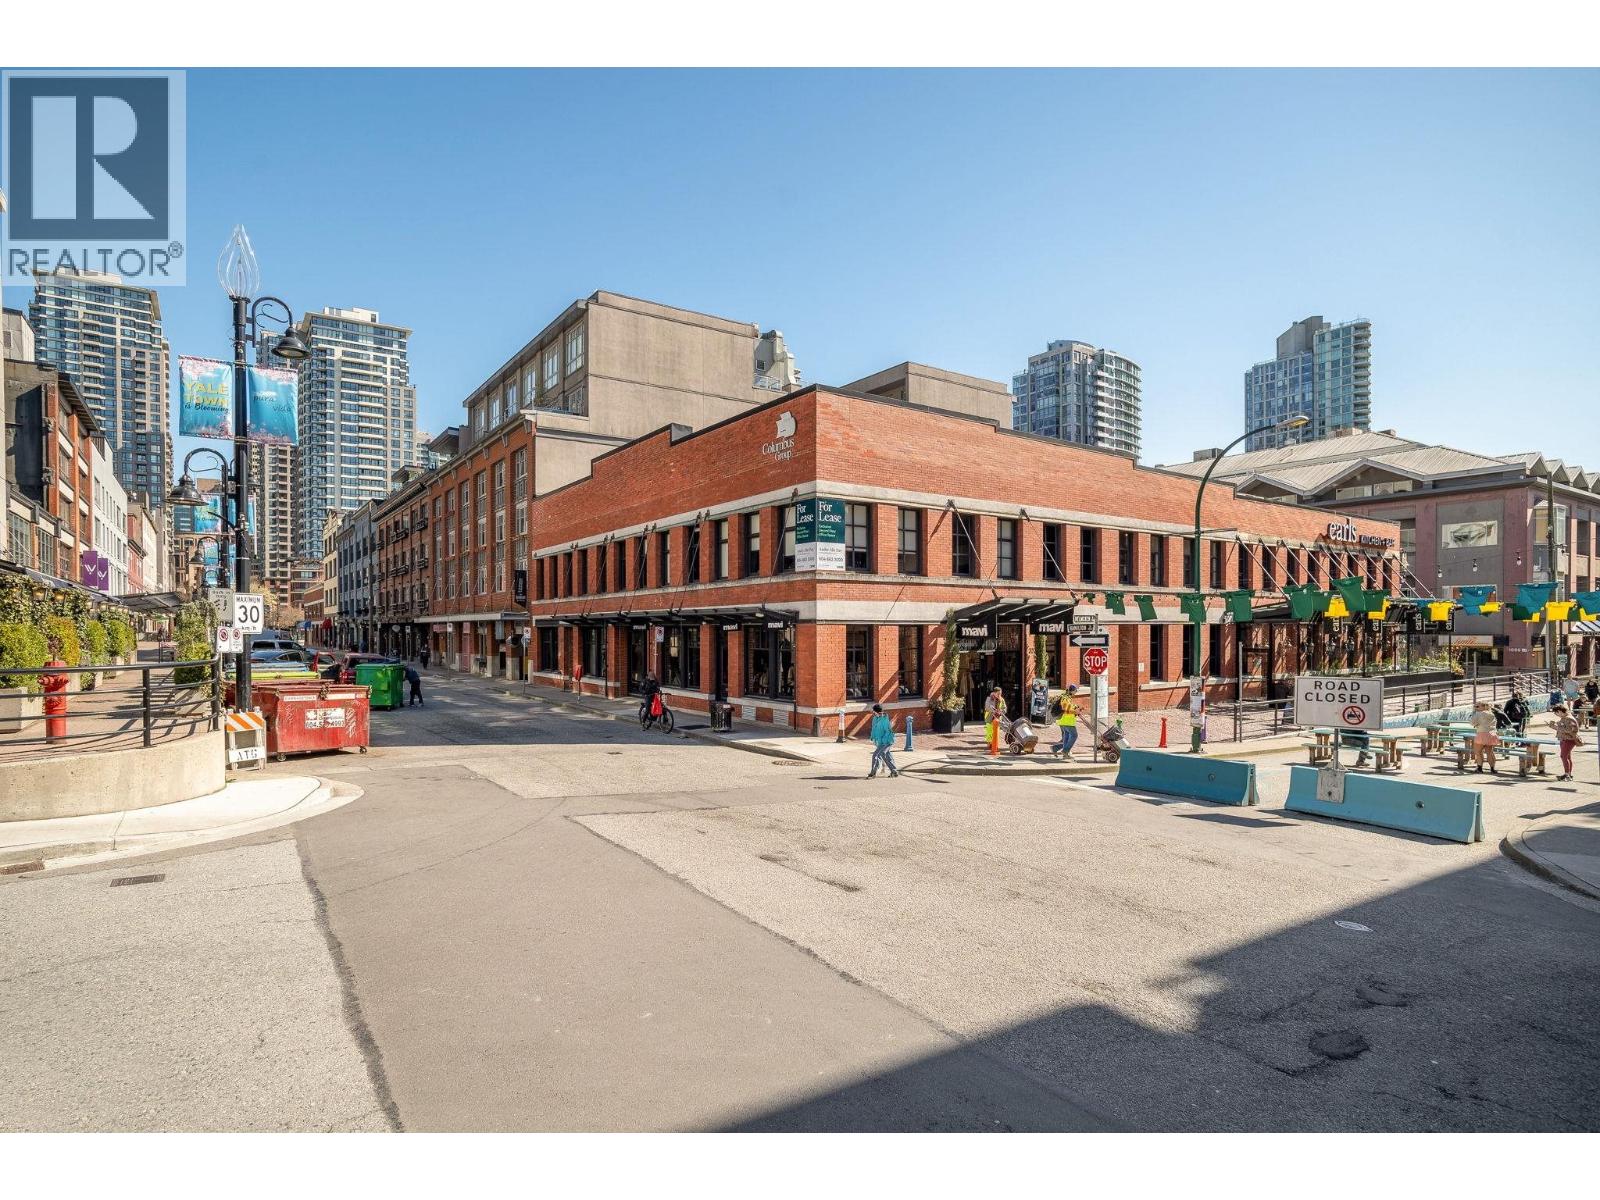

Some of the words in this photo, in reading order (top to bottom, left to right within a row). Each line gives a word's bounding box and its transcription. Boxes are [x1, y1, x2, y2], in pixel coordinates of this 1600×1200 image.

[184, 382, 229, 395] YALE
[762, 438, 795, 455] Columbus
[774, 449, 792, 462] Group
[797, 503, 806, 513] For
[818, 500, 833, 511] For
[797, 511, 814, 524] Lease
[818, 511, 842, 523] Lease
[1329, 516, 1357, 543] earls
[236, 596, 261, 604] MAXIMUM
[238, 604, 260, 623] 30
[767, 620, 784, 629] mavi
[961, 624, 988, 637] mavi
[1038, 621, 1065, 633] mavi
[1084, 656, 1108, 668] STOP
[1314, 680, 1361, 692] ROAD
[1304, 692, 1371, 704] CLOSED
